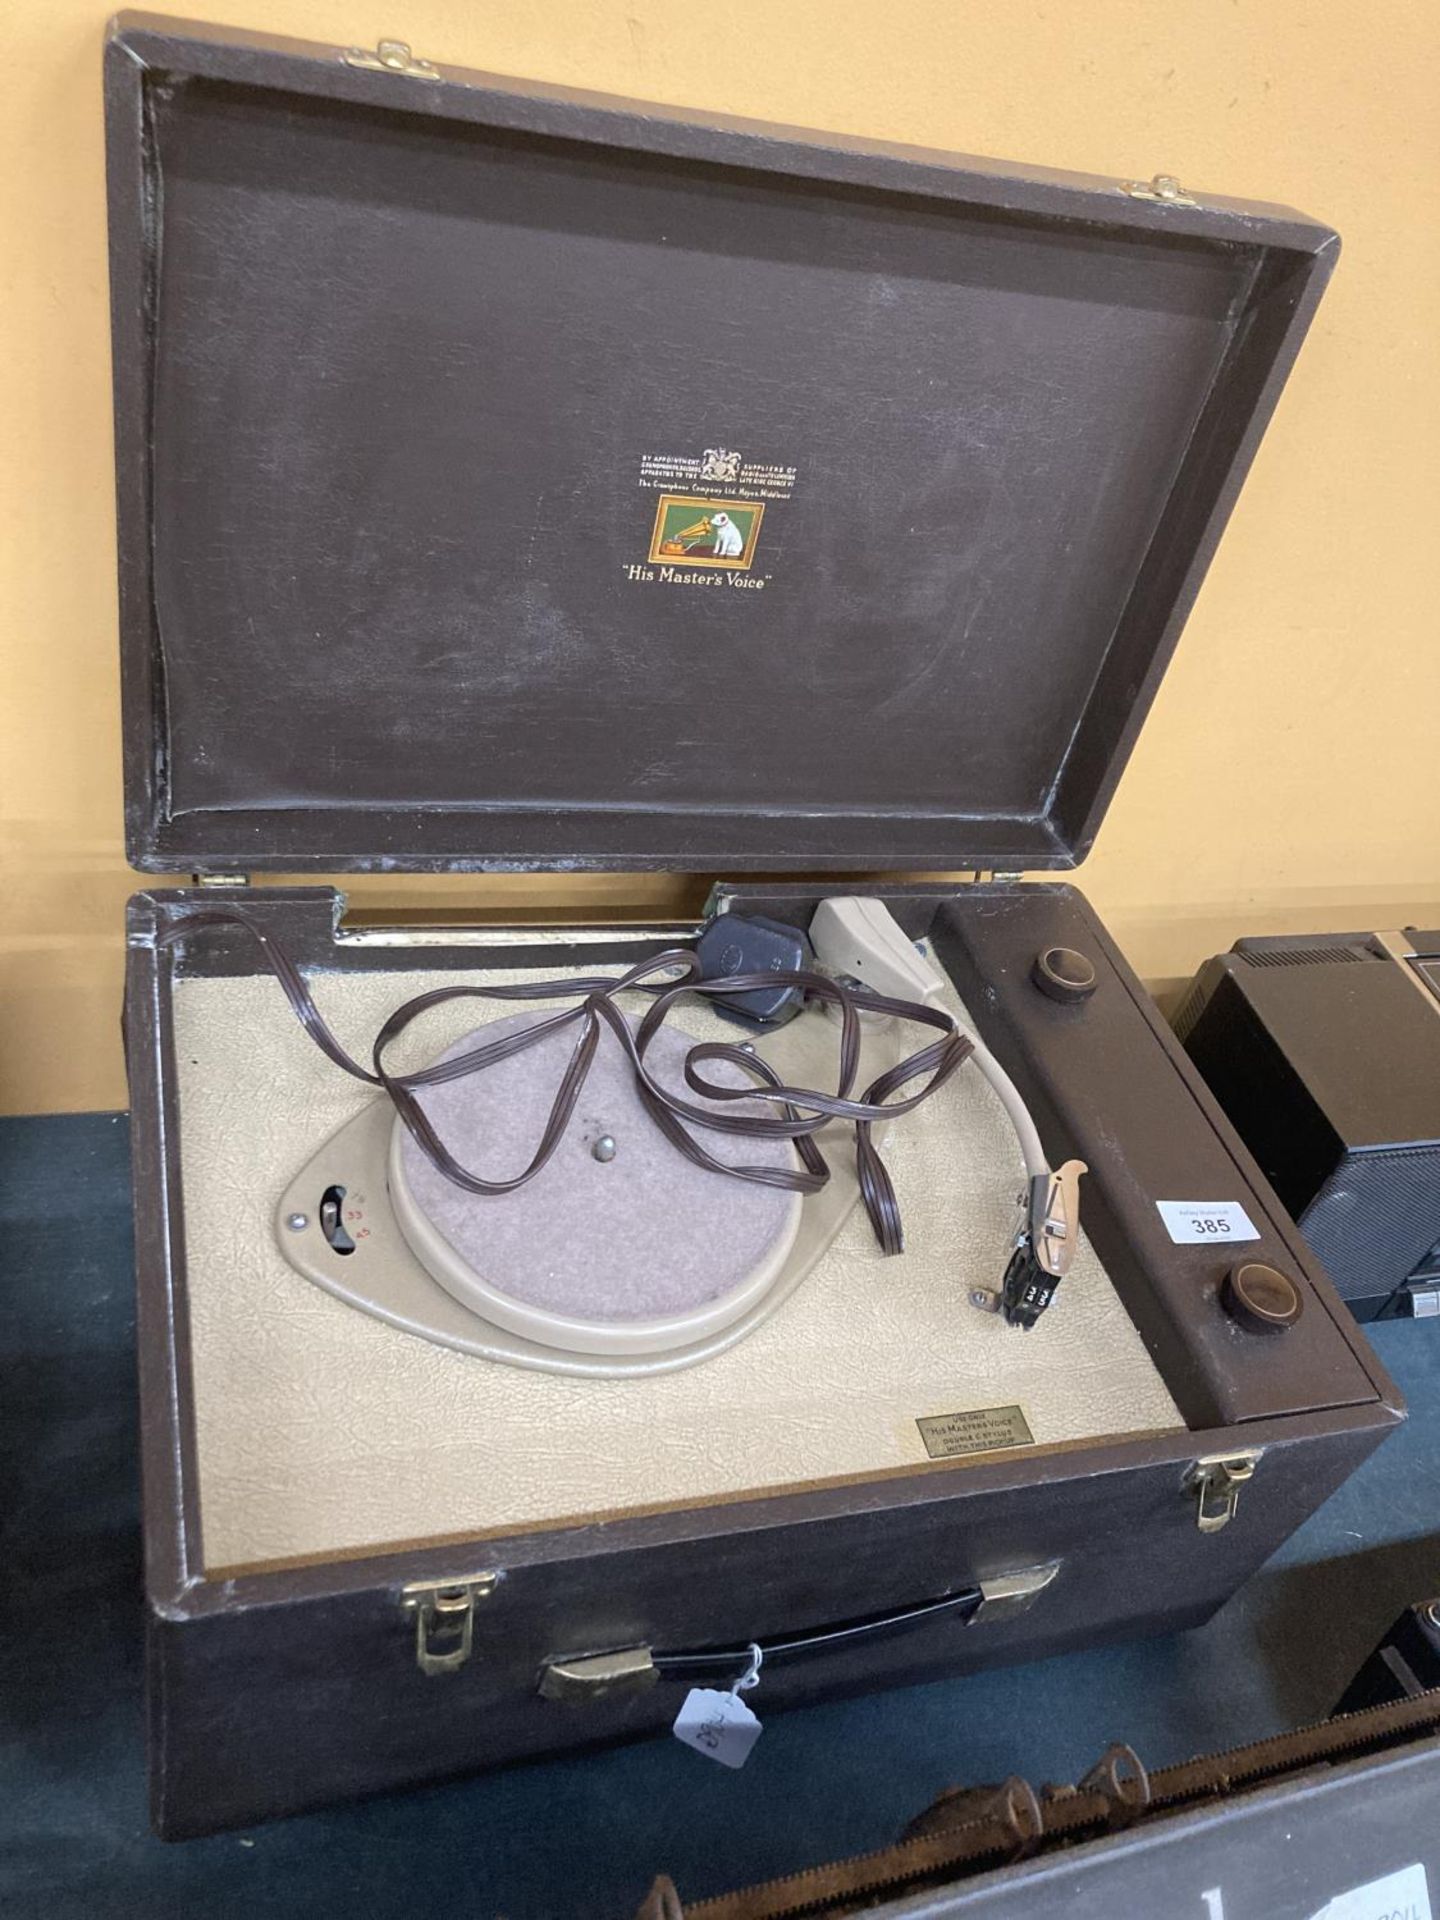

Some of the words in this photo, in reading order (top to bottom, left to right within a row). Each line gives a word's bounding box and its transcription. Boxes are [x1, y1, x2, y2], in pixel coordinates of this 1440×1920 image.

[692, 484, 722, 496] Company
[659, 566, 723, 586] Master's
[1191, 1219, 1231, 1234] 385
[356, 1228, 371, 1239] 45
